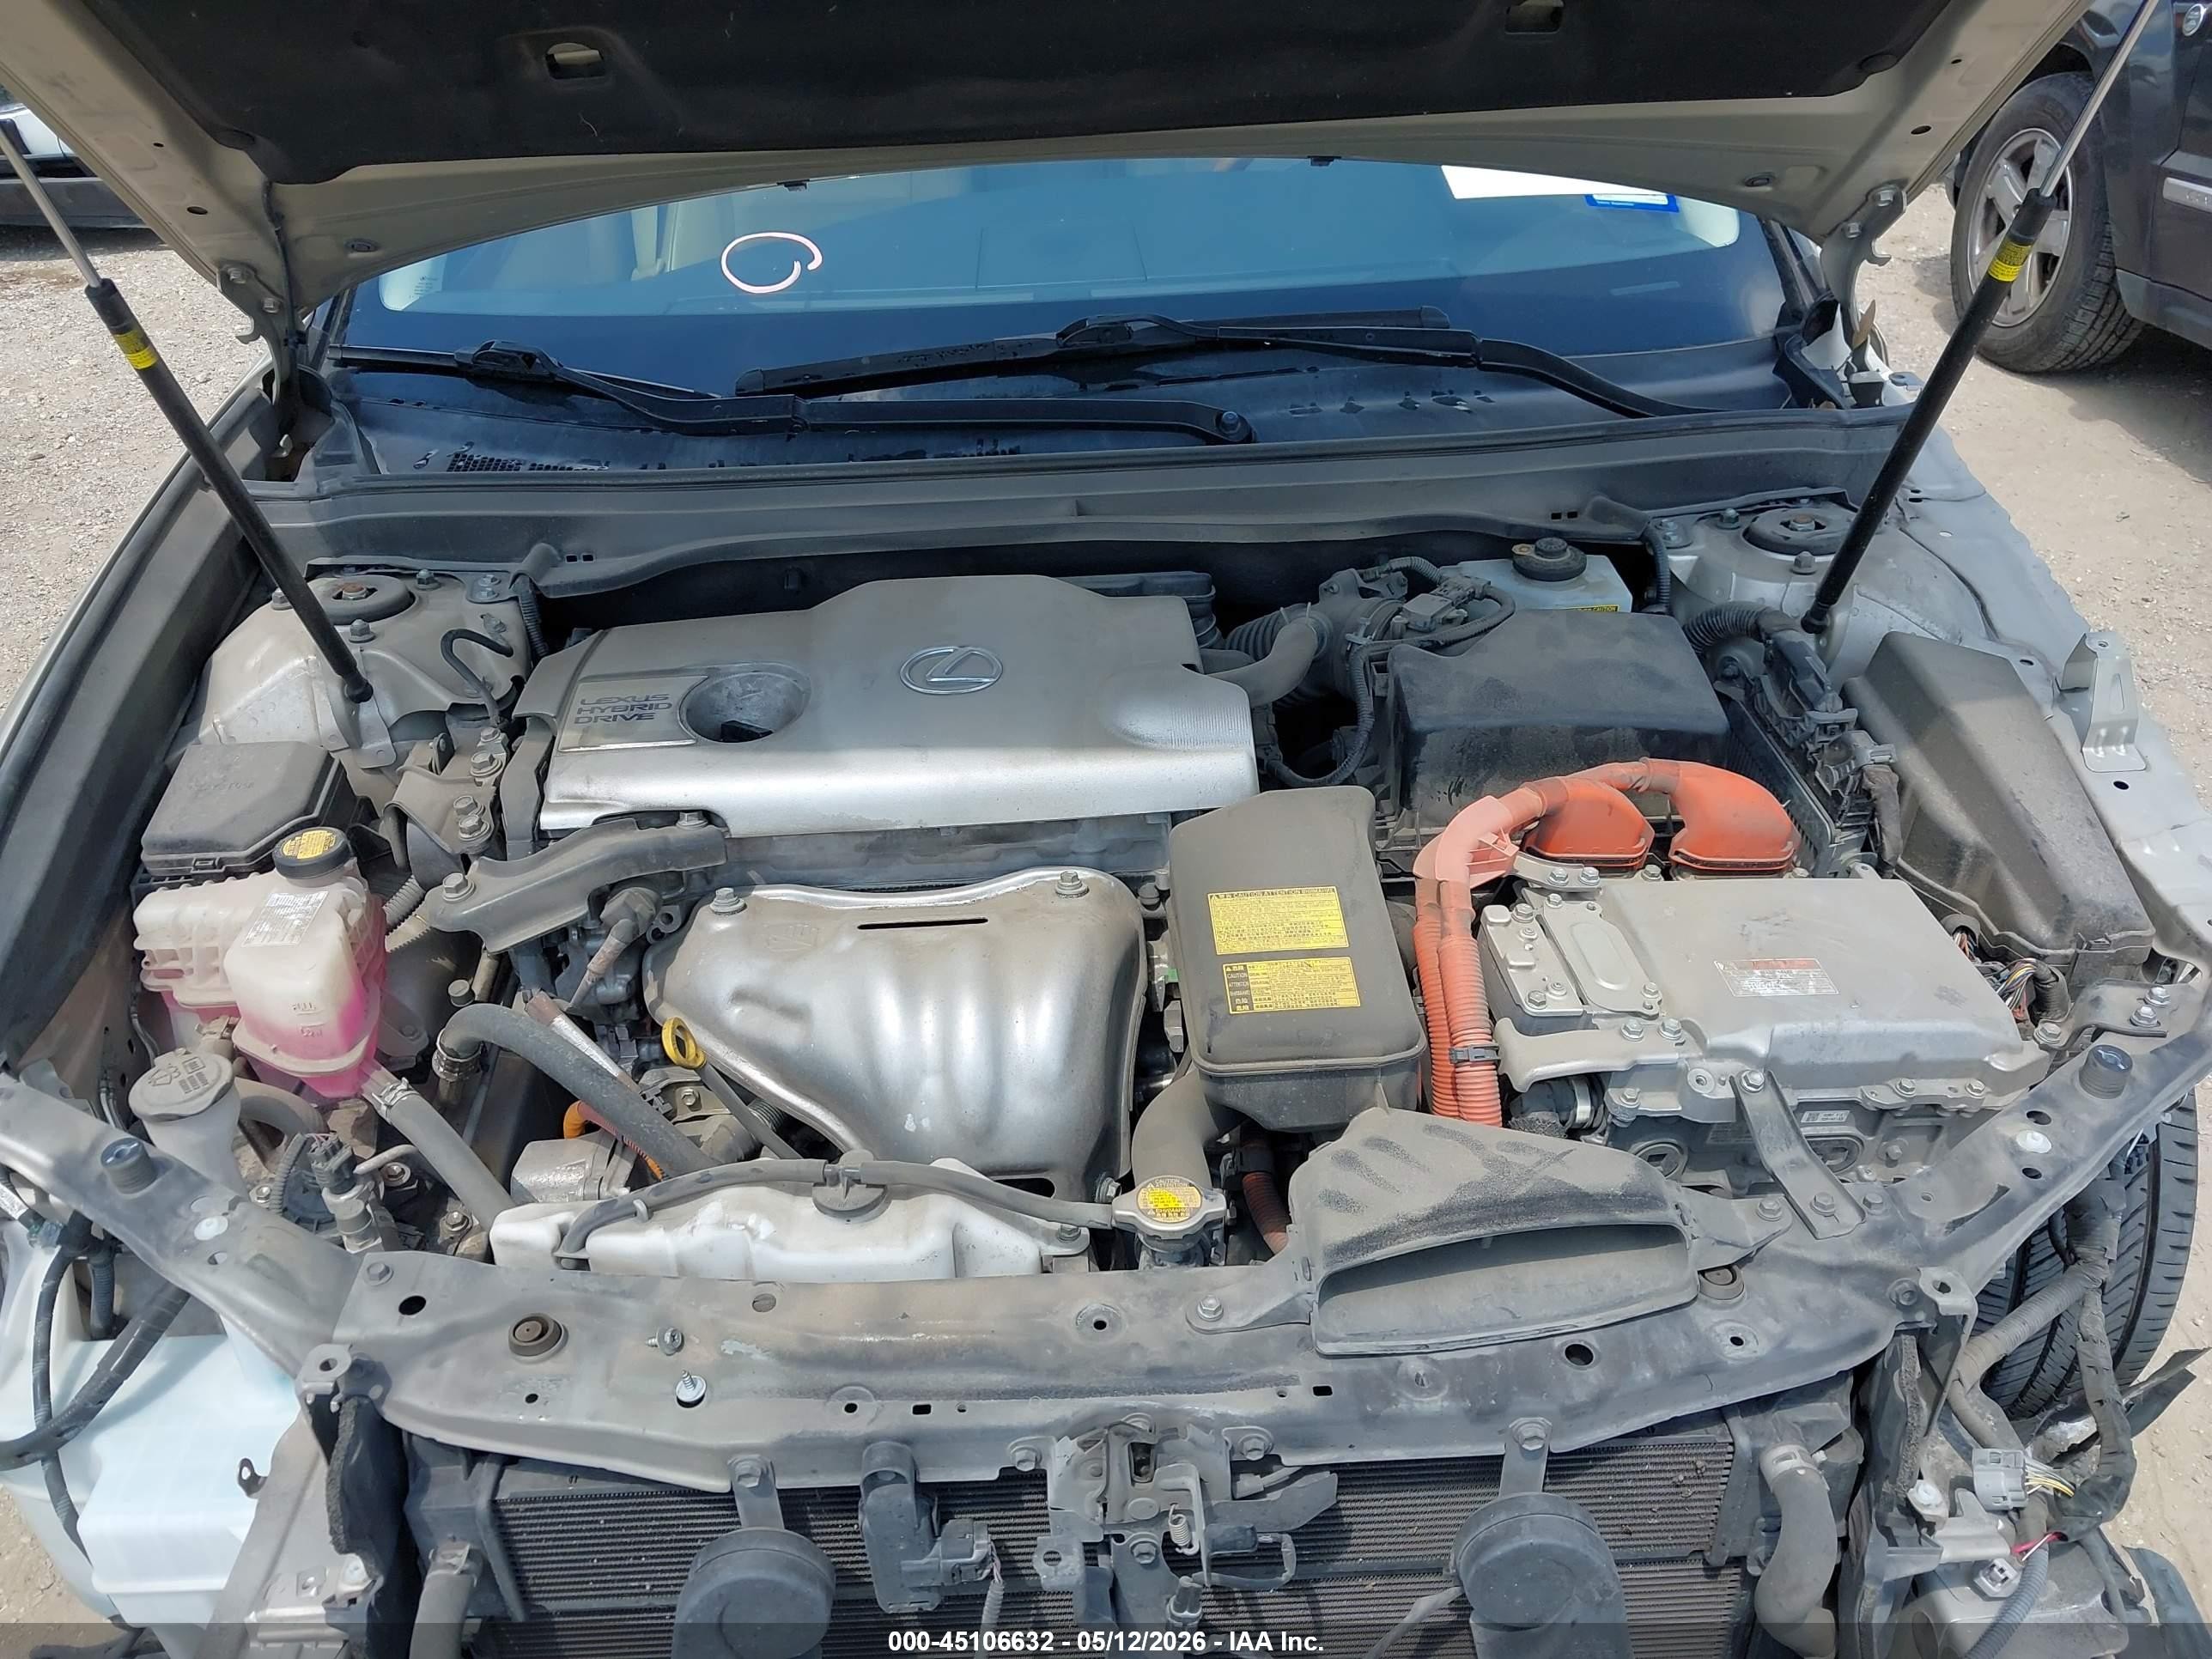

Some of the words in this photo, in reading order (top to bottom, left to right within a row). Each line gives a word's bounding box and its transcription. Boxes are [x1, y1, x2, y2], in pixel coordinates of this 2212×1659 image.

[580, 694, 670, 706] LEXUS
[576, 702, 673, 715] HYBRID
[574, 712, 656, 725] DRIVE
